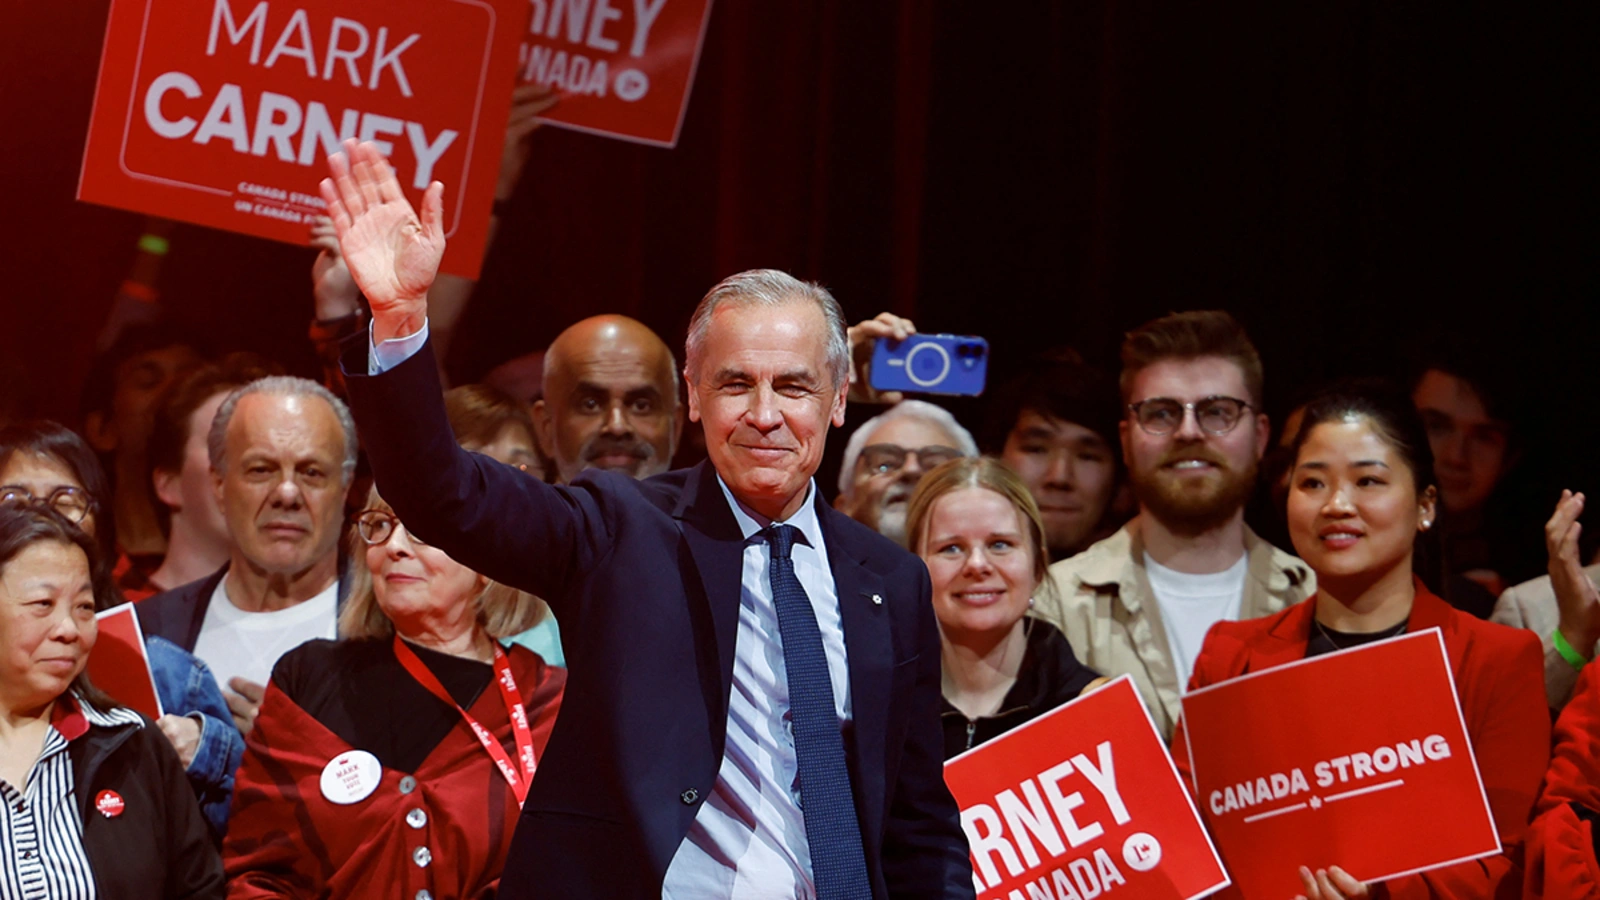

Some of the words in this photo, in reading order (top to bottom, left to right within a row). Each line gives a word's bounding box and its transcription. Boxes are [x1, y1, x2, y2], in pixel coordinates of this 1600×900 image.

[206, 0, 420, 97] MARK
[144, 71, 458, 190] CARNEY
[234, 200, 253, 213] UN
[254, 204, 302, 222] CANADA
[237, 181, 288, 201] CANADA
[289, 191, 328, 209] STRON
[1209, 767, 1310, 816] CANADA
[1314, 734, 1452, 788] STRONG
[960, 740, 1131, 895] RNEY
[993, 847, 1126, 900] NADA
